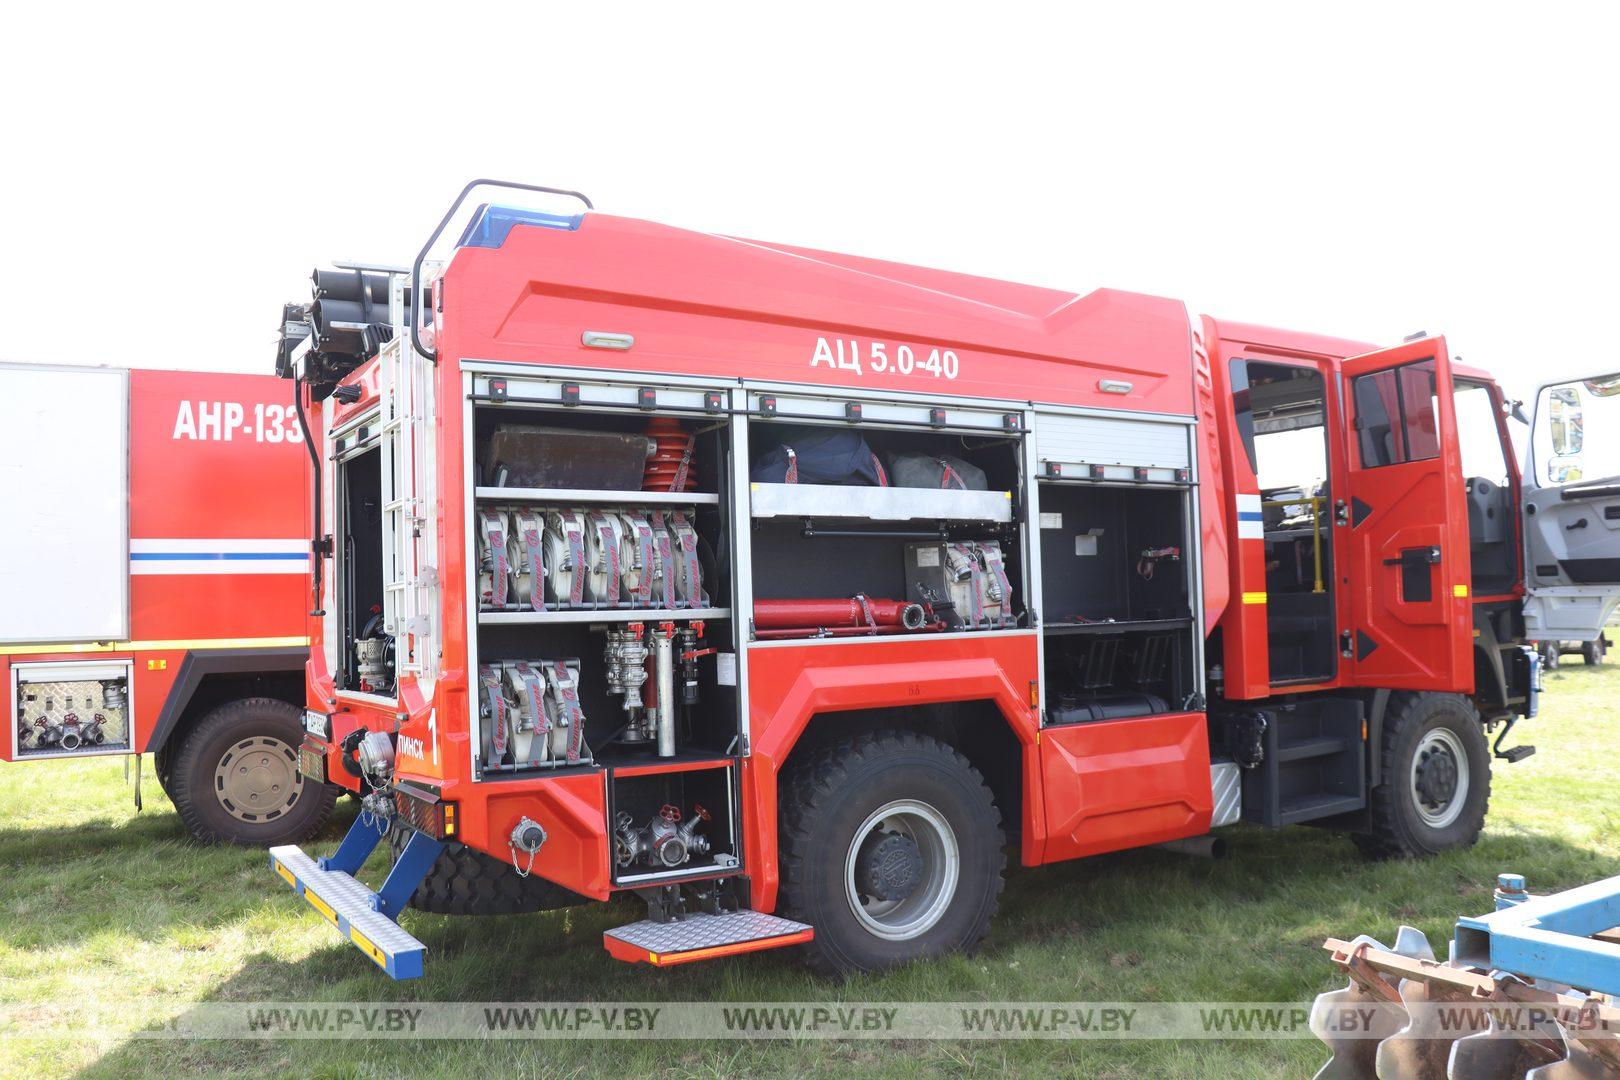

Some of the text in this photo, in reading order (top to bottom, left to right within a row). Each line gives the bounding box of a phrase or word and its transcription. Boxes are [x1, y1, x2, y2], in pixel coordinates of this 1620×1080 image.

[810, 337, 959, 379] АЦ 5.0-40
[397, 734, 424, 760] ПИНСК
[428, 708, 437, 765] 1
